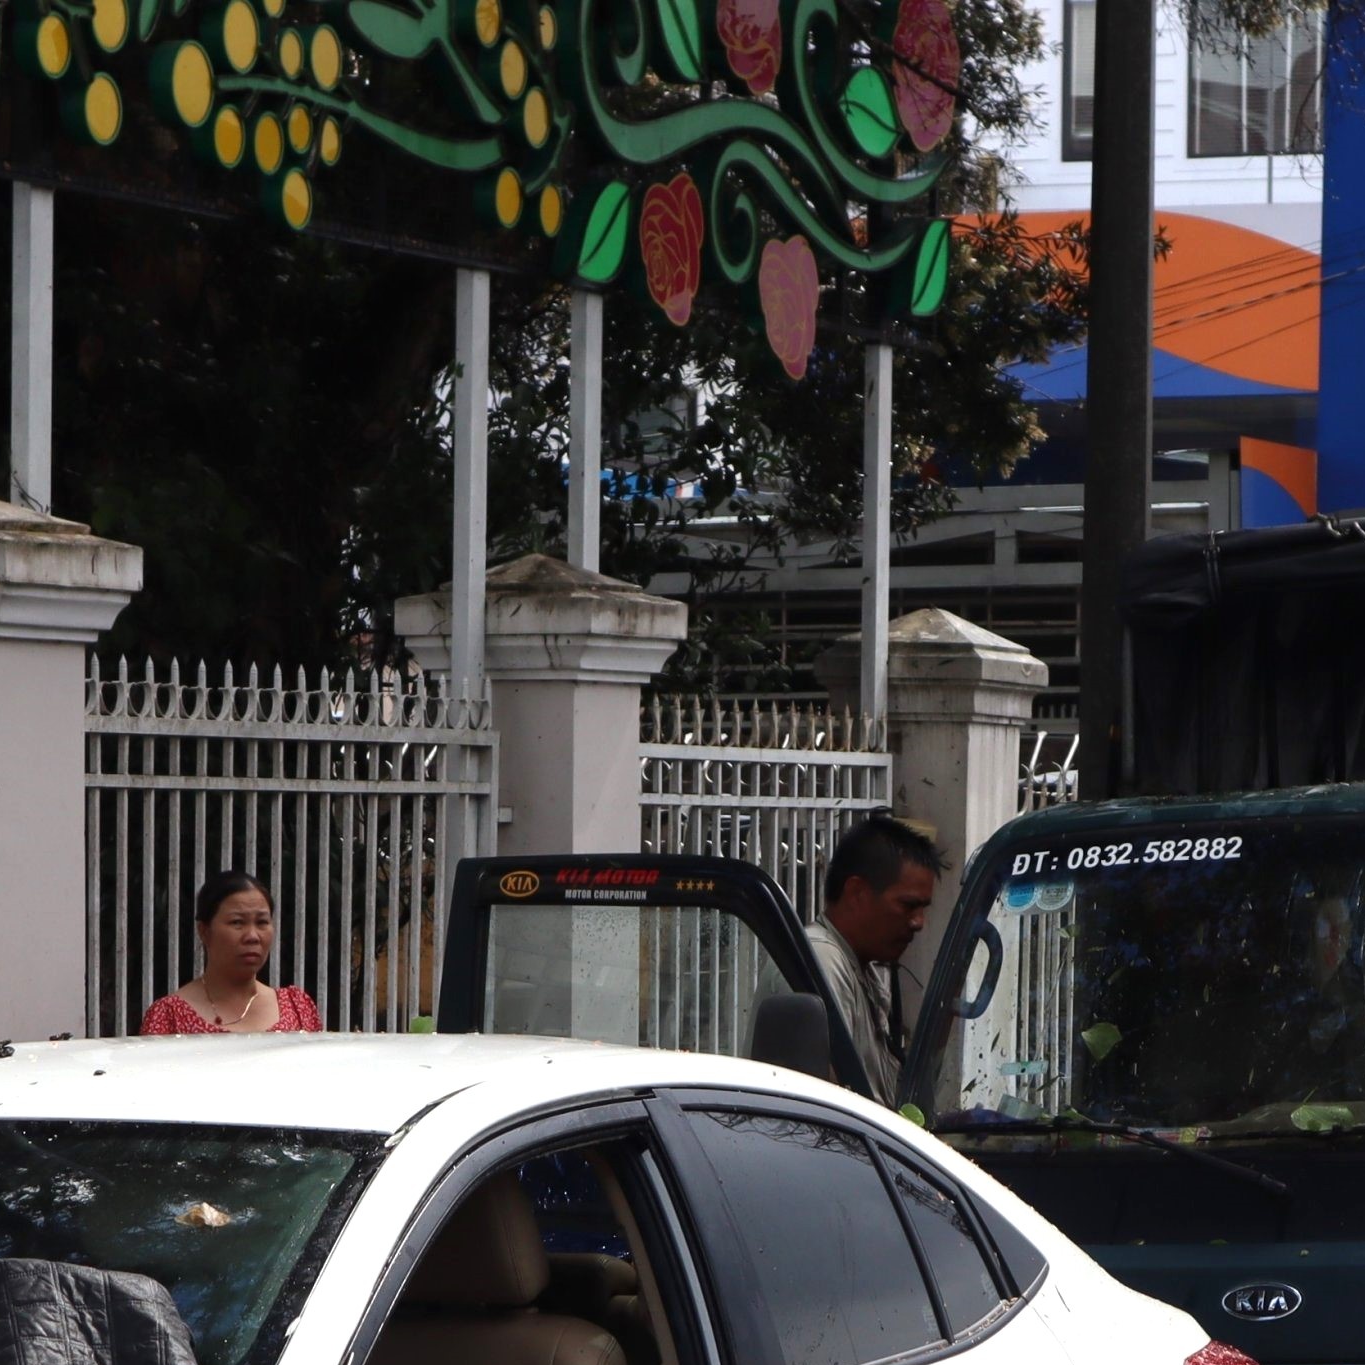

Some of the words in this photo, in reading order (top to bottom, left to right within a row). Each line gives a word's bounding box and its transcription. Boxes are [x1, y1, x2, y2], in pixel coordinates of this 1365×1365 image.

[1011, 852, 1059, 876] ĐT:
[1066, 836, 1244, 871] 0832.582882
[564, 888, 592, 899] MOTOR
[593, 889, 647, 900] CORPORATION
[1236, 1289, 1289, 1311] KIA
